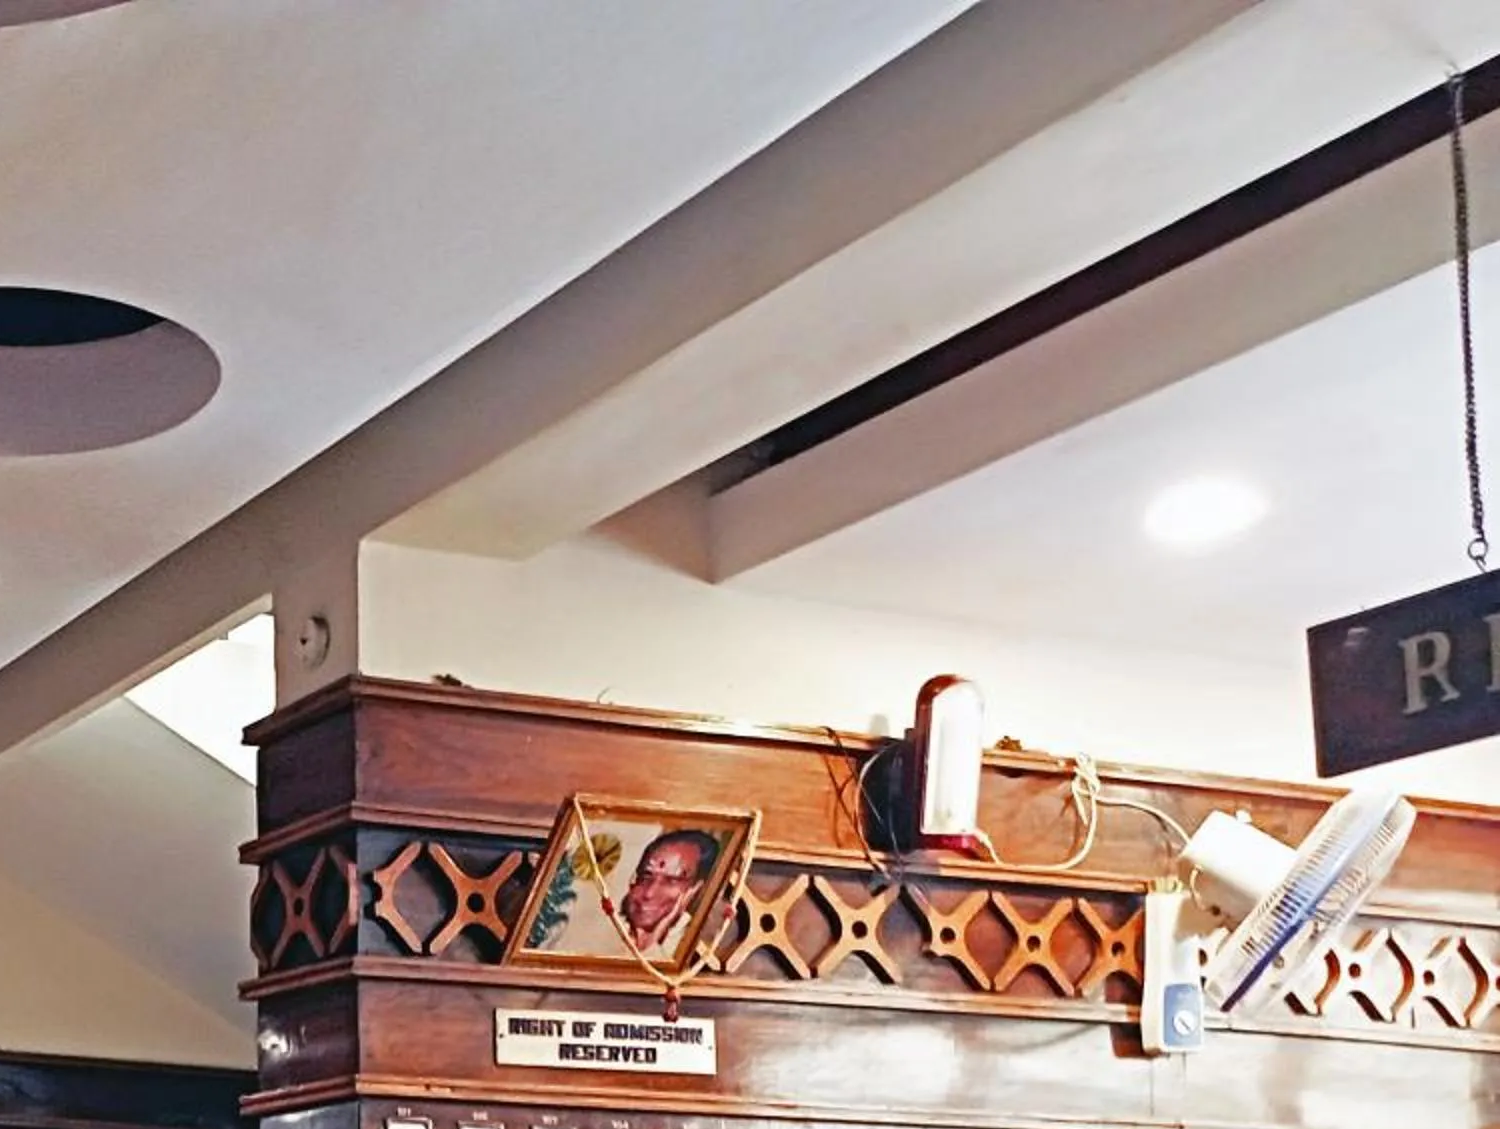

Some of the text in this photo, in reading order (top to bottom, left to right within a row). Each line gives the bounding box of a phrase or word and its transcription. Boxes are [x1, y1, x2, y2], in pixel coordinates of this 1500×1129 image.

[508, 1017, 703, 1045] RIGHT OF ADMISSION
[558, 1043, 657, 1065] RESERVED
